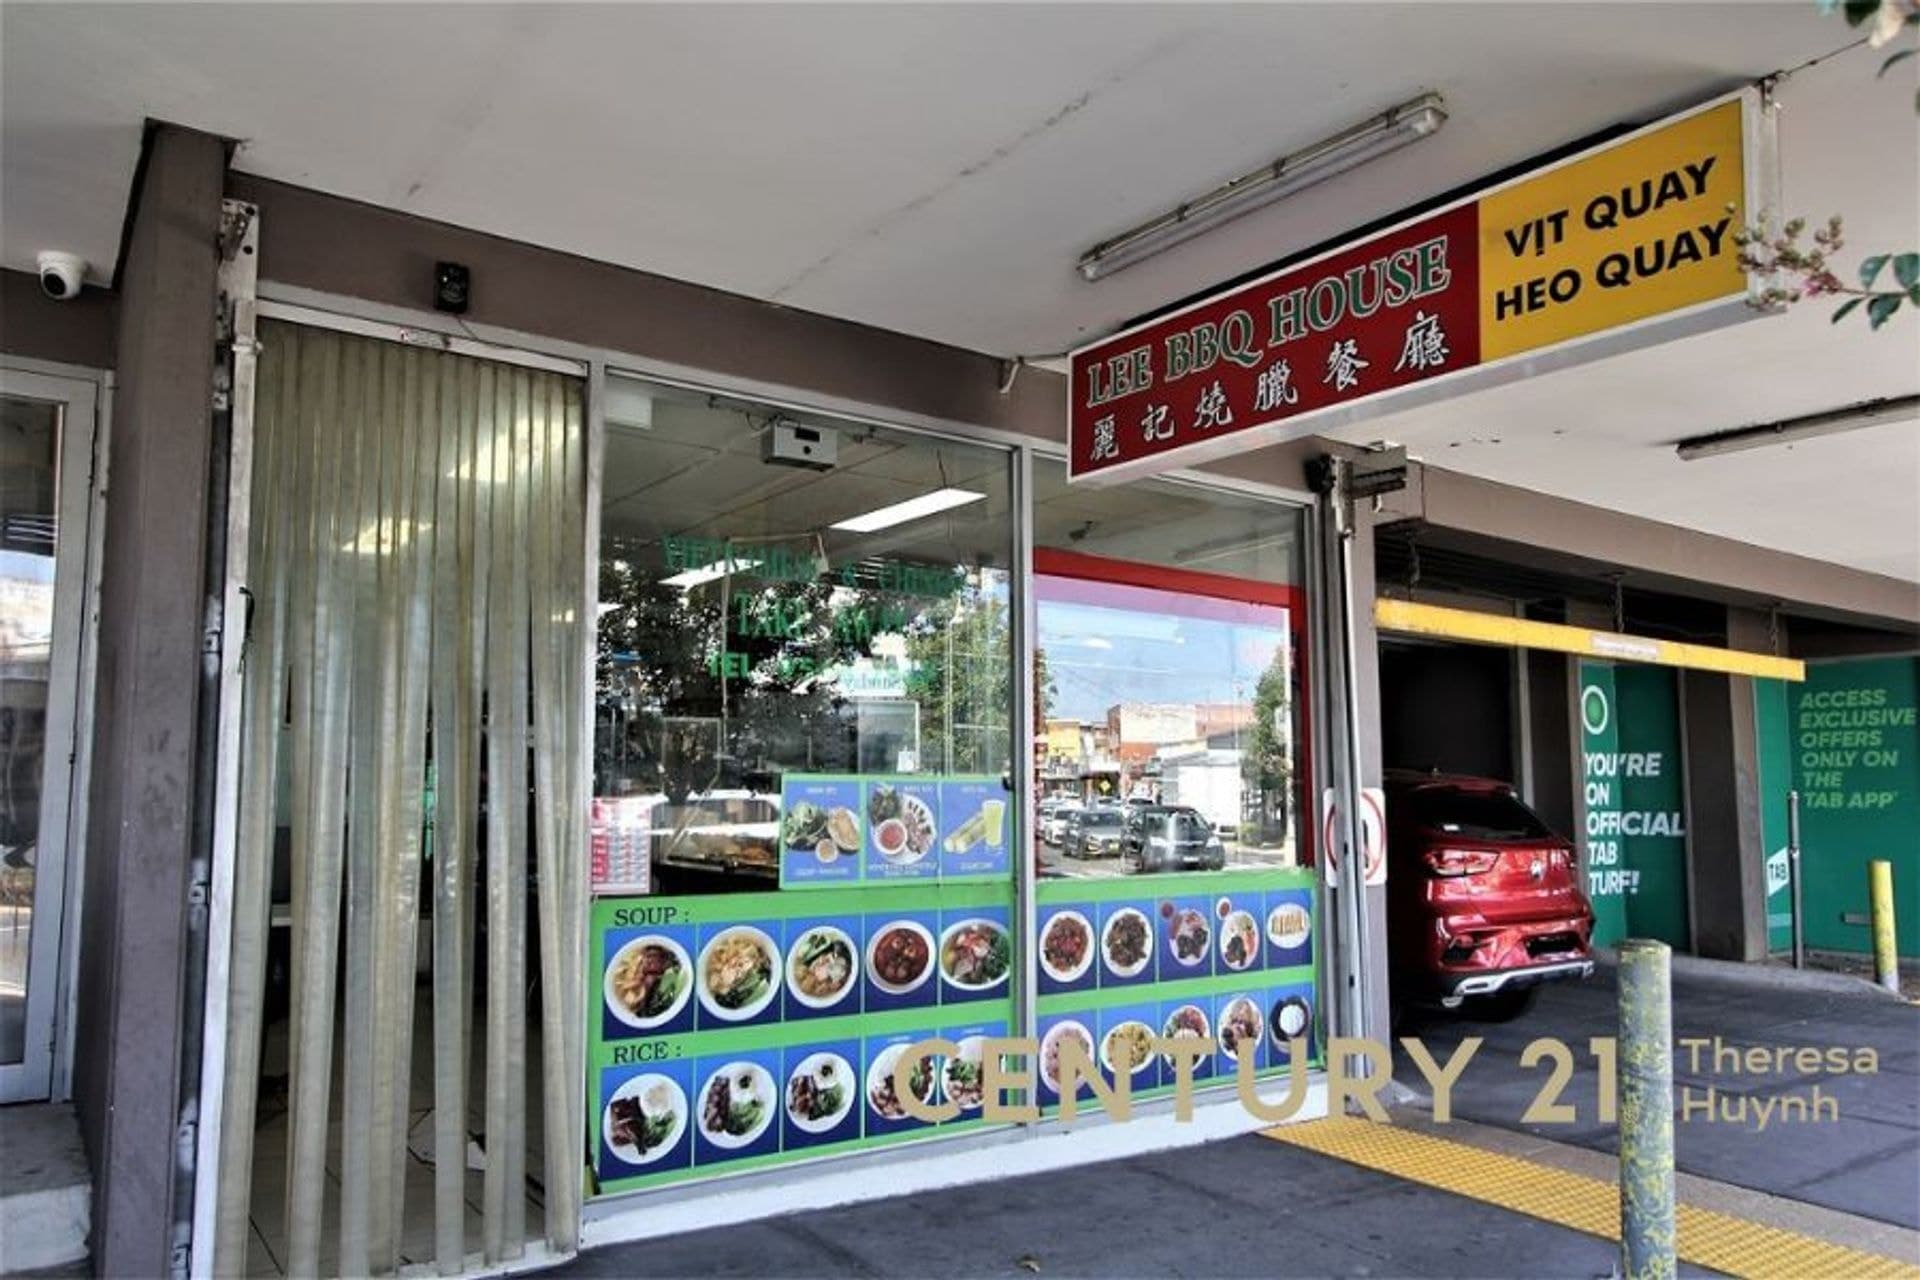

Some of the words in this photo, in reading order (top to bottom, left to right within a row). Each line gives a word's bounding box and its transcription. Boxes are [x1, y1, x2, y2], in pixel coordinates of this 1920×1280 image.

[1504, 209, 1569, 257] VỊT
[1584, 156, 1717, 230] QUAY
[1496, 269, 1581, 321] HEO
[1595, 218, 1731, 288] QUAY
[1087, 346, 1153, 408] LEE
[1164, 310, 1263, 384] BBQ
[1268, 235, 1452, 347] HOUSE
[1800, 689, 1887, 709] ACCESS
[1800, 708, 1917, 728] EXCLUSIVE
[1801, 730, 1882, 748] OFFERS
[1585, 752, 1662, 777] YOU'RE
[1802, 751, 1858, 768] ONLY
[1863, 751, 1898, 767] ON
[1803, 771, 1843, 787] THE
[1586, 782, 1610, 806] ON
[1804, 791, 1844, 808] TAB
[1587, 811, 1686, 836] OFFICIAL
[1588, 841, 1618, 865] TAB
[1589, 870, 1640, 895] TURF!
[1768, 862, 1787, 881] TAB
[614, 907, 677, 927] SOUP
[613, 1041, 669, 1064] RICE
